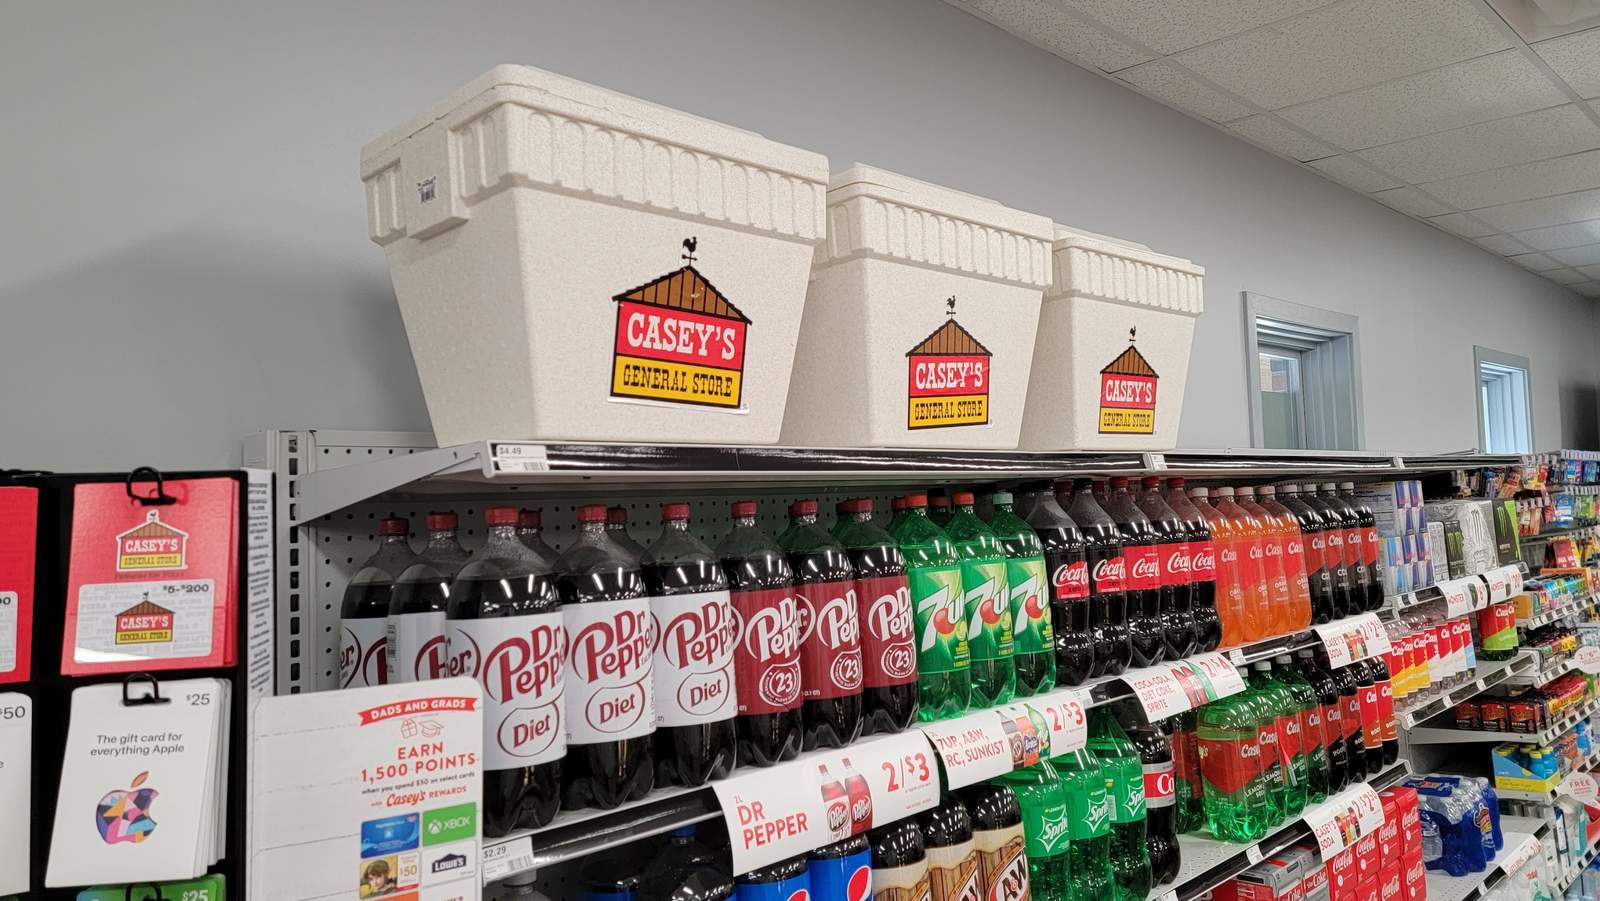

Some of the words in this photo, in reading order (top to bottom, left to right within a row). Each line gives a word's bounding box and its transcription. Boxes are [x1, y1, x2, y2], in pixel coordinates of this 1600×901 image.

[626, 311, 737, 361] CASEY'S
[622, 363, 688, 393] GENERAL
[691, 373, 734, 398] STORE
[915, 361, 984, 390] CASEY'S
[1105, 378, 1153, 403] CASEY'S
[914, 402, 955, 421] GENERAL
[957, 399, 984, 418] STORE
[1103, 412, 1131, 429] GENERAL
[1132, 412, 1151, 428] STORE
[125, 539, 178, 553] CASEY'S
[162, 584, 209, 594] $5-$200
[120, 615, 169, 630] CASEY'S
[614, 610, 645, 646] Dr
[701, 601, 728, 634] Dr
[530, 624, 561, 664] Dr
[844, 659, 859, 679] 23
[894, 649, 910, 668] 23
[690, 679, 722, 707] Diet
[775, 672, 794, 693] 23
[186, 693, 210, 706] $25
[370, 704, 402, 720] DADS
[404, 701, 429, 713] AND
[431, 698, 467, 709] GRADS
[599, 693, 636, 725] Diet
[1147, 699, 1169, 713] SPRITE
[1046, 701, 1084, 732] 2/$3
[97, 734, 117, 745] The
[120, 733, 138, 745] gift
[140, 733, 165, 743] card
[168, 732, 183, 742] for
[513, 714, 551, 748] Diet
[90, 745, 152, 758] everything
[153, 744, 184, 755] Apple
[398, 742, 444, 760] EARN
[945, 752, 967, 768] RC,
[965, 740, 1006, 762] SUNKIST
[361, 763, 408, 785] 1,500
[415, 752, 476, 774] POINTS
[881, 751, 931, 793] 2/$3
[361, 786, 380, 795] when
[381, 785, 393, 793] you
[395, 781, 415, 792] spend
[439, 774, 458, 783] select
[459, 771, 475, 779] cards
[1568, 779, 1591, 788] FREE
[386, 789, 427, 807] Casey's
[429, 785, 467, 798] REWARDS
[443, 816, 471, 831] XBOX
[737, 800, 766, 826] DR
[743, 812, 808, 850] PEPPER
[484, 846, 507, 859] $2.29
[434, 857, 465, 871] LOWE'S
